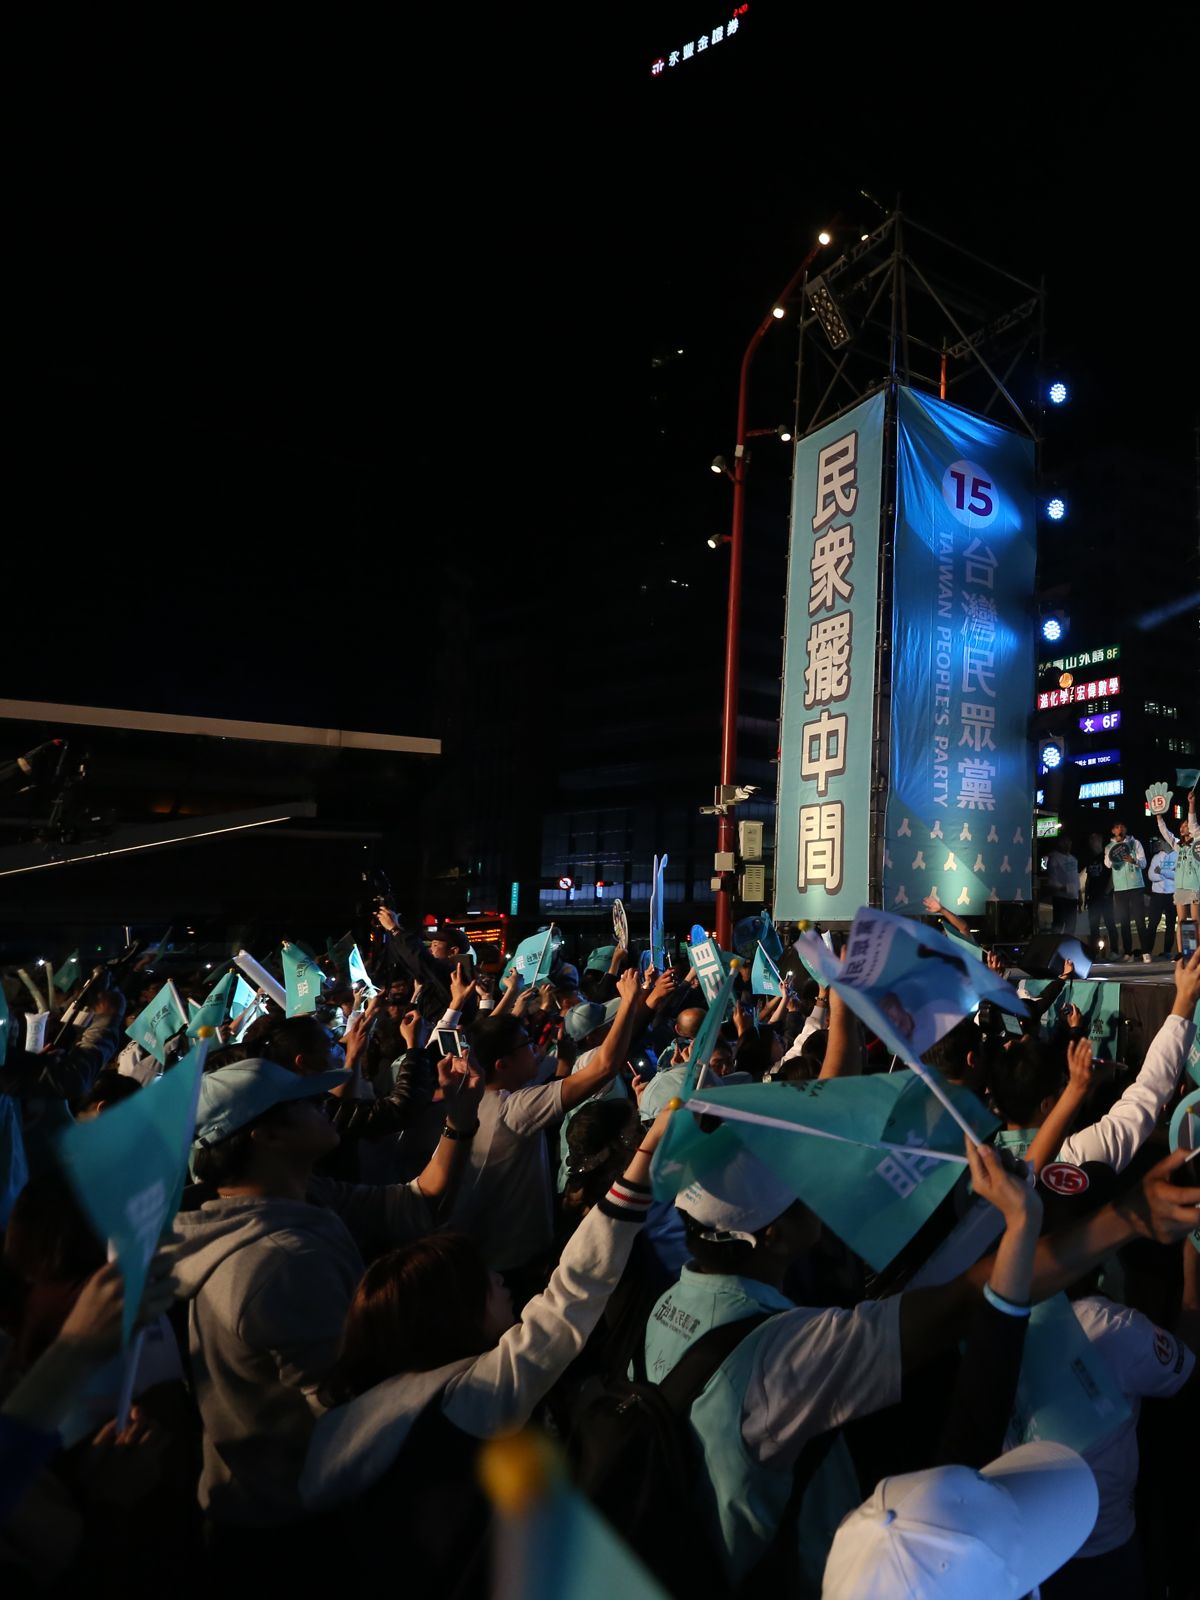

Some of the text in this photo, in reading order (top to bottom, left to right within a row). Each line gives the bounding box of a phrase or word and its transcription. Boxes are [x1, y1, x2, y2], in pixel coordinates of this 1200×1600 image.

[949, 469, 994, 517] 15
[1106, 648, 1118, 660] 8F
[932, 530, 954, 809] TAIWAN PEOPLE'S PARTY
[957, 537, 999, 812] 台灣民眾黨
[1102, 713, 1118, 729] 6F
[1152, 797, 1163, 807] 15
[1051, 1170, 1080, 1189] 15
[1156, 1333, 1170, 1358] 15
